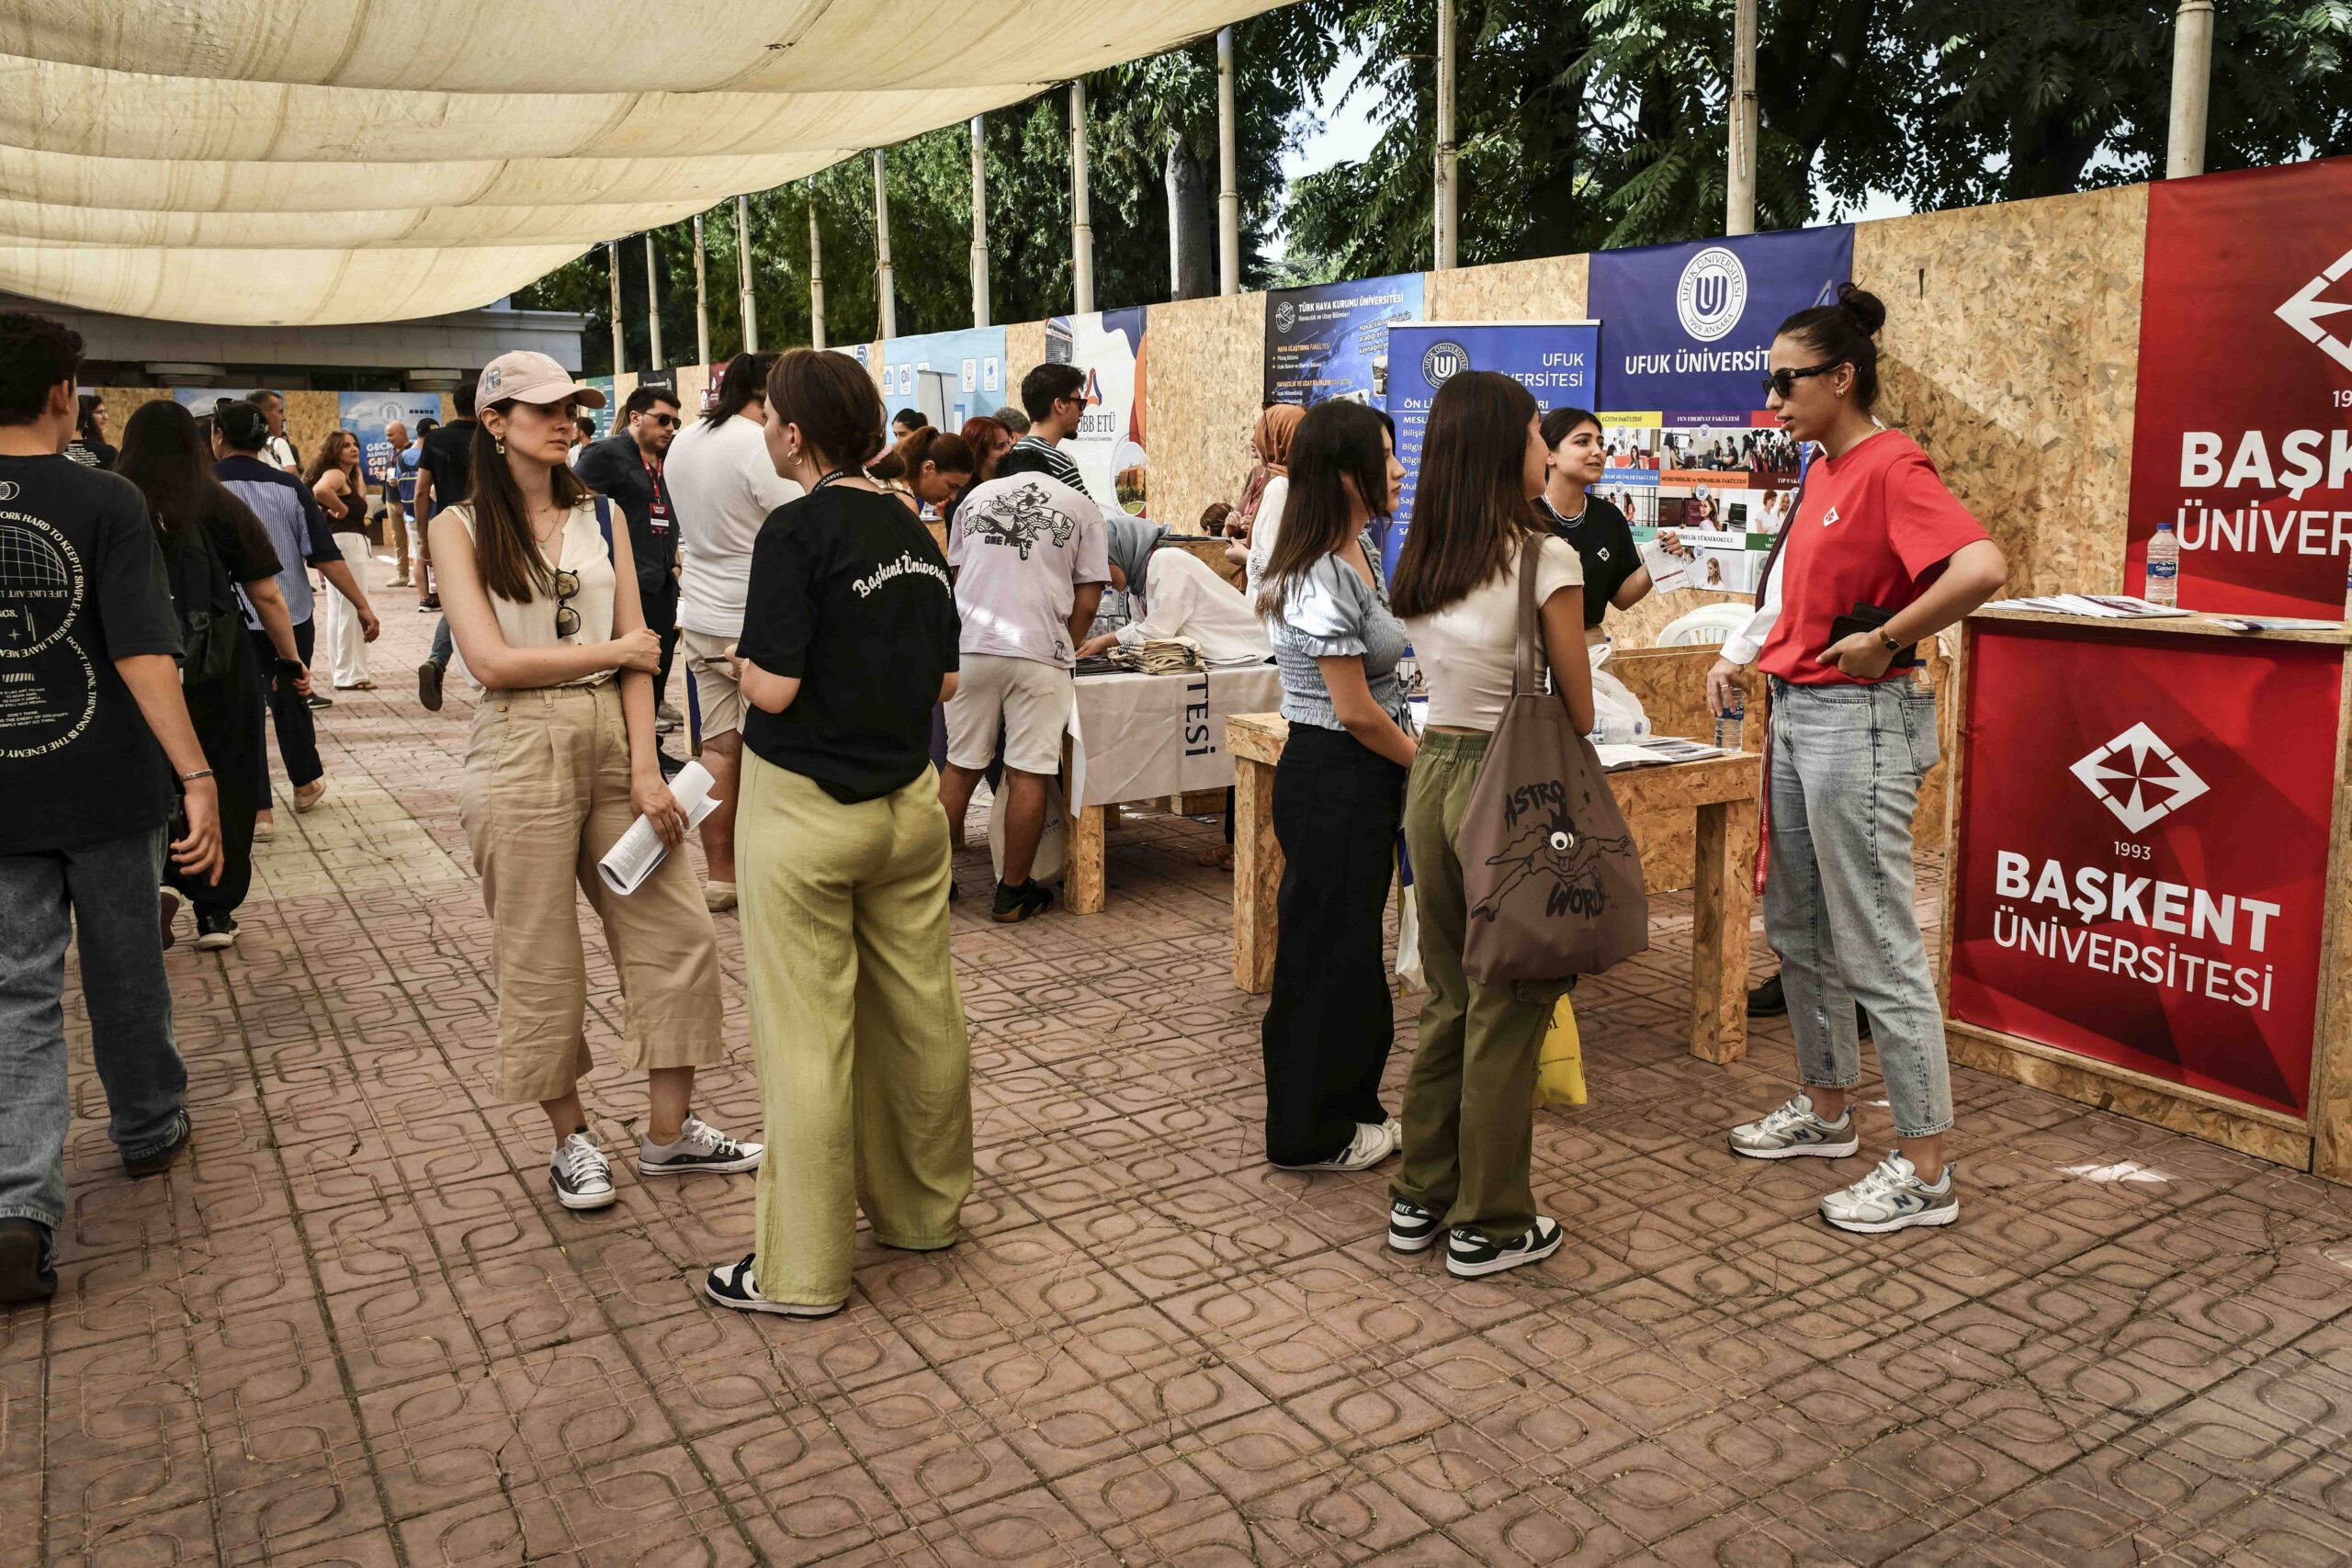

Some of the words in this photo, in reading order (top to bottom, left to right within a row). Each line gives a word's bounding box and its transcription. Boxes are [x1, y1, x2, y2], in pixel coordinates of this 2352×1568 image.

[1682, 269, 1697, 301] UFUK
[1298, 301, 1315, 312] TÜRK
[1315, 300, 1331, 311] HAVA
[1332, 298, 1358, 310] KURUMU
[1360, 290, 1404, 307] ÜNİVERSİTESİ
[1703, 312, 1735, 334] ANKARA
[1543, 353, 1584, 367] UFUK
[1625, 353, 1670, 375] UFUK
[1404, 398, 1421, 409] ÖN
[1097, 411, 1116, 433] ETÜ
[1404, 416, 1428, 424] MESL
[1402, 443, 1423, 453] Bilgis
[1401, 456, 1421, 465] Bilgis
[1400, 497, 1415, 506] Sağ
[0, 511, 21, 521] ORK
[22, 513, 51, 531] HARD
[50, 527, 63, 542] TO
[984, 535, 1003, 546] ONE
[60, 540, 80, 564] KEEP
[852, 558, 904, 599] Başkent
[71, 575, 85, 611] SIMPLE
[62, 609, 77, 628] AND
[20, 641, 47, 658] HAVE
[75, 691, 96, 731] THINKING
[6, 745, 48, 758] ENEMY
[48, 736, 71, 751] THE
[1504, 780, 1566, 832] ASTRO
[2114, 840, 2152, 861] 1993
[1996, 850, 2281, 953] BAŞKENT
[1993, 904, 2274, 1011] ÜNİVERSİTESİ
[1394, 1201, 1412, 1214] NIKE
